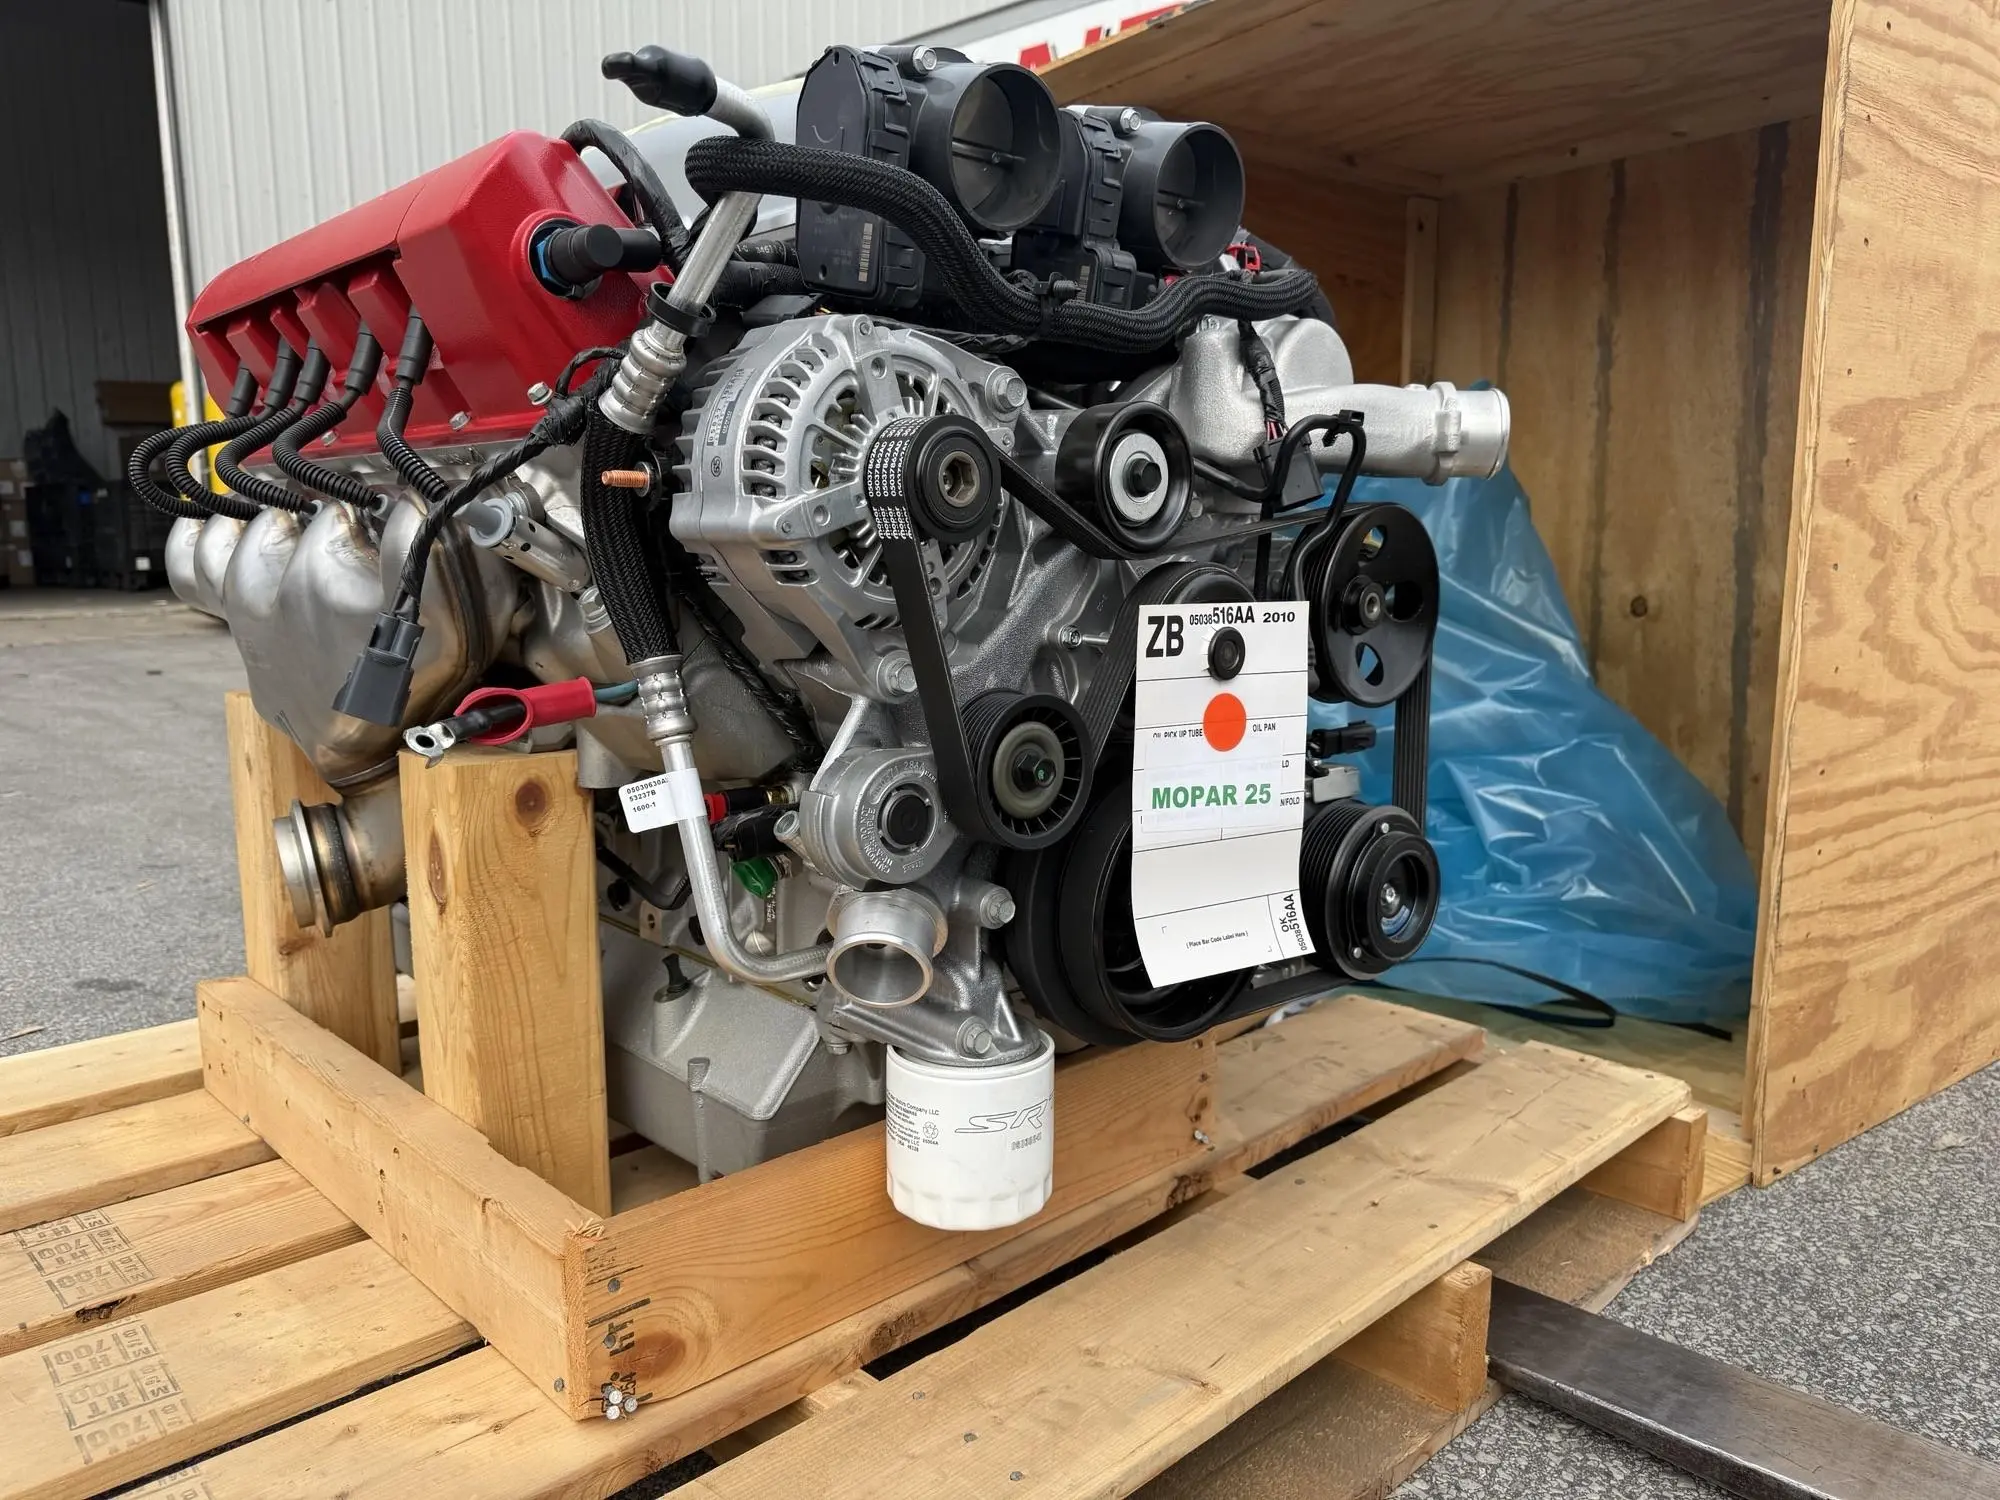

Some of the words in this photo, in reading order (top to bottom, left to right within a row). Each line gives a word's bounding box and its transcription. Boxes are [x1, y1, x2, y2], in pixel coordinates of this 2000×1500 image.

[1190, 606, 1255, 625] 05038516AA
[1263, 612, 1295, 623] 2010
[1146, 615, 1184, 658] ZB
[1188, 729, 1203, 737] TUBE
[1253, 724, 1262, 732] OIL
[1264, 723, 1276, 731] PAN
[629, 789, 656, 802] 53237B
[1152, 785, 1237, 809] MOPAR
[1244, 784, 1271, 805] 25
[632, 802, 656, 813] 1600-1
[1279, 917, 1289, 932] OK
[1283, 894, 1307, 951] 05038516AA
[907, 1103, 927, 1114] Company
[38, 1238, 90, 1260] 700
[54, 1340, 112, 1365] 700
[73, 1357, 113, 1376] HT
[87, 1391, 131, 1419] HT
[85, 1416, 151, 1448] 700
